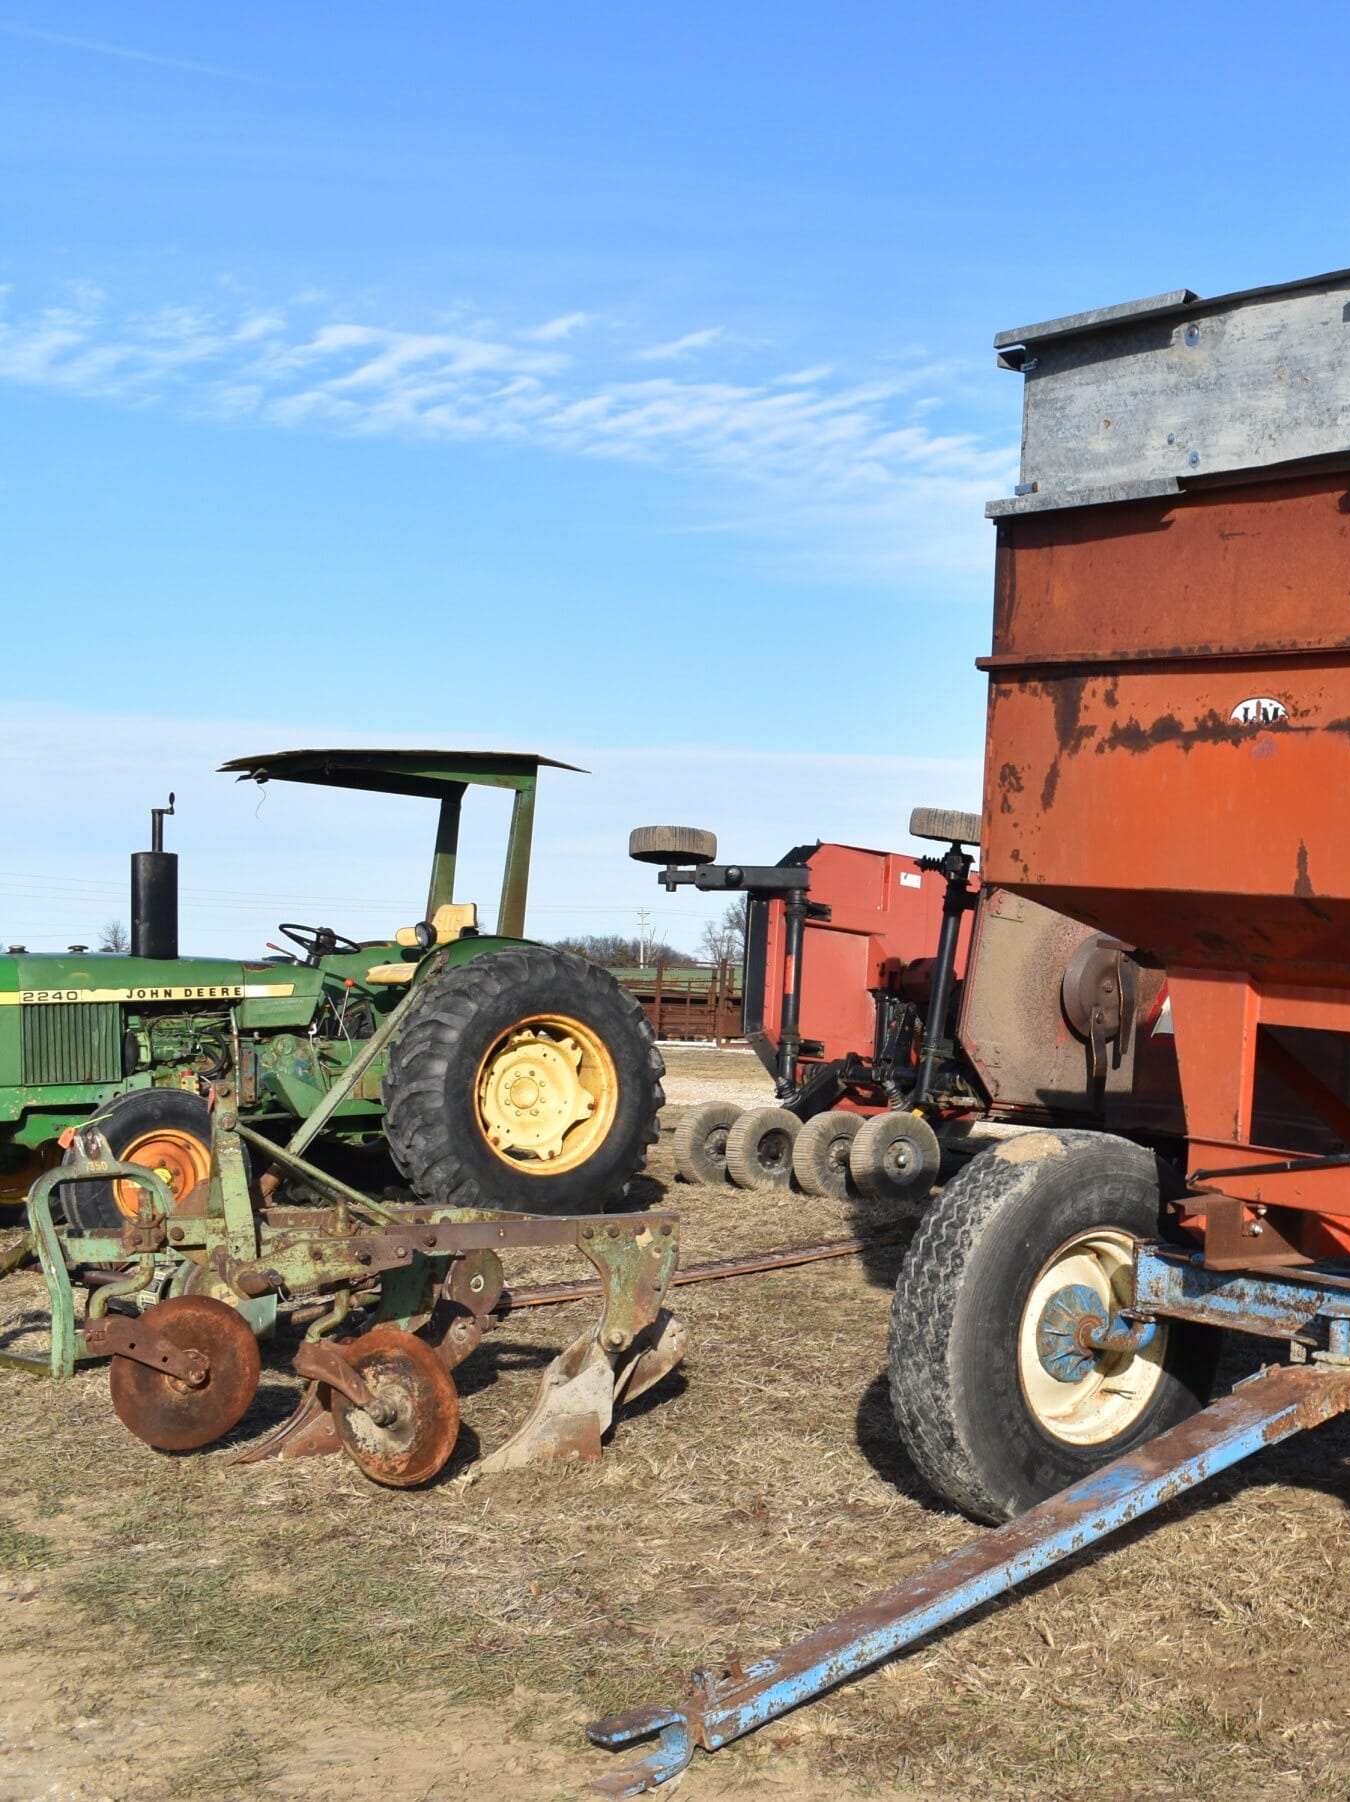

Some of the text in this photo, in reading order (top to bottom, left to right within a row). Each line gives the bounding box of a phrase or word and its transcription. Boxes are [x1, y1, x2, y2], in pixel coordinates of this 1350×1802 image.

[22, 990, 78, 1002] 2240
[126, 987, 241, 999] JOHN DEERE
